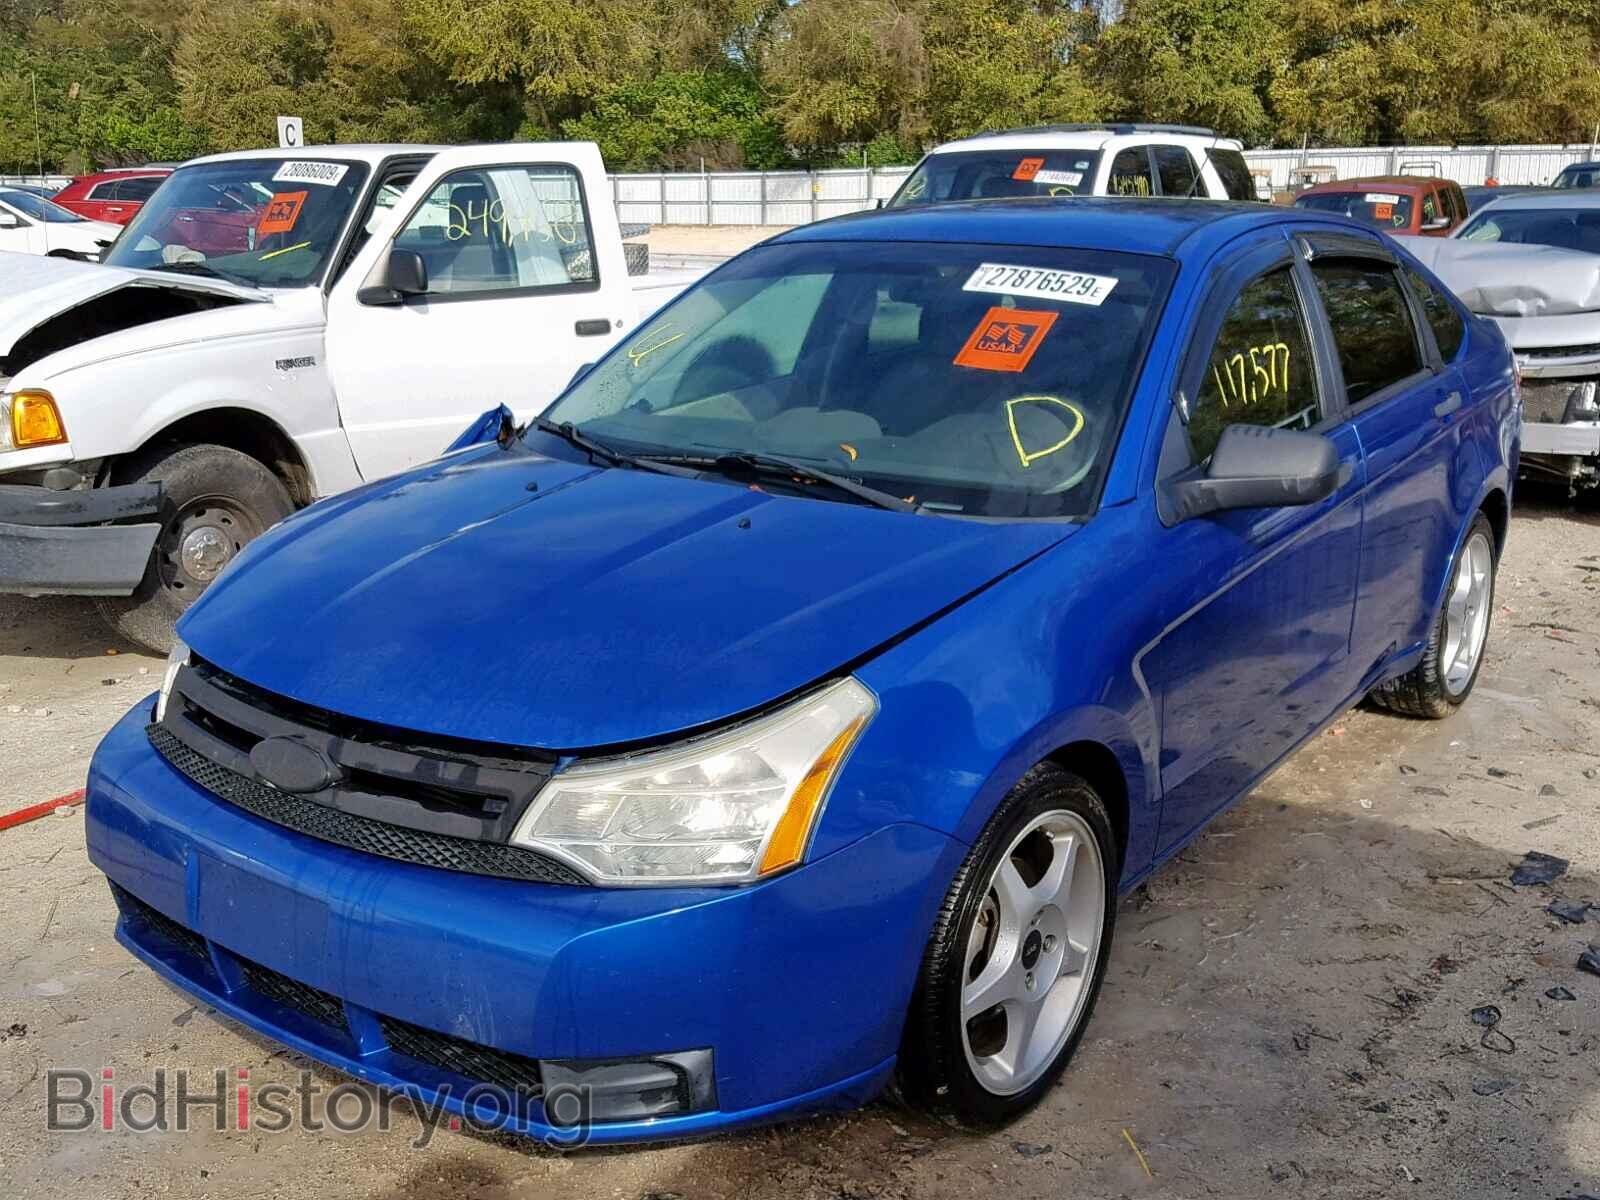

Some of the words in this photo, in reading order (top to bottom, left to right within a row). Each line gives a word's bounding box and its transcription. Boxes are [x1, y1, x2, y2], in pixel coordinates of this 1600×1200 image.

[285, 124, 296, 146] C
[977, 340, 1017, 353] USAA
[1006, 396, 1084, 467] D
